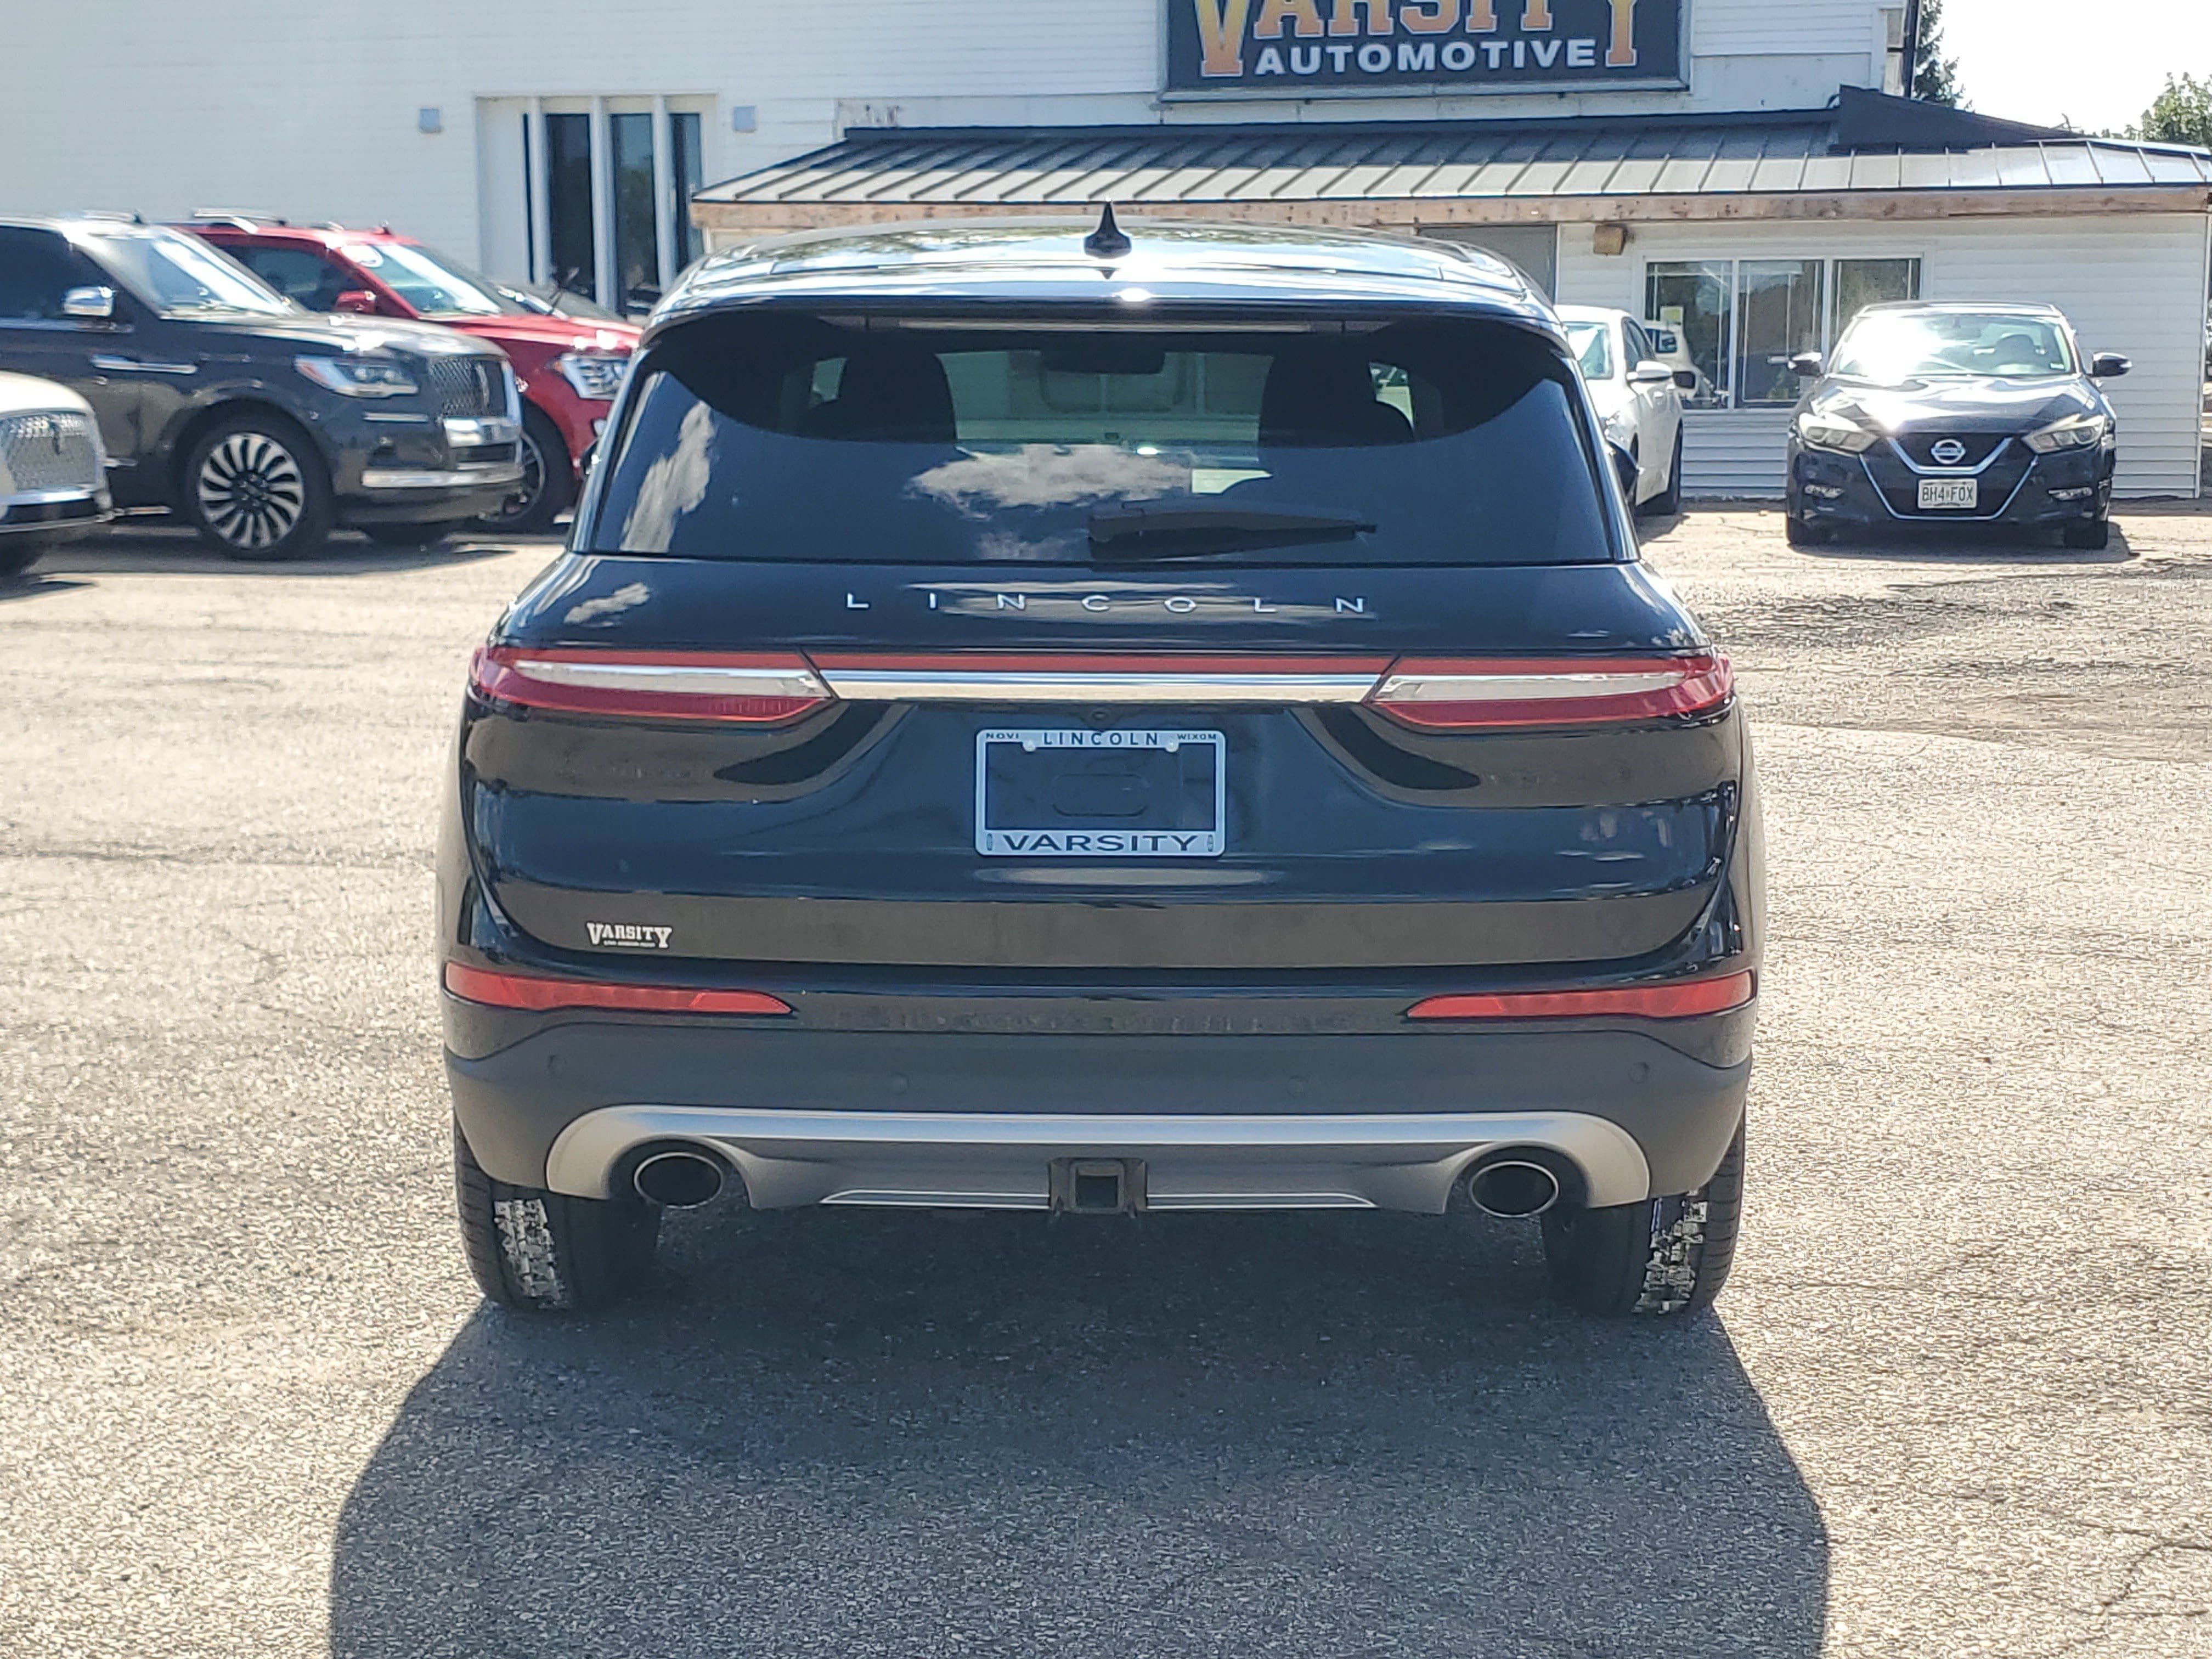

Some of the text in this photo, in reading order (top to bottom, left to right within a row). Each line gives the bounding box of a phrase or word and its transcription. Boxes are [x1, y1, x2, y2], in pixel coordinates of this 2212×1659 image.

[1254, 38, 1597, 75] AUTOMOTIVE
[845, 591, 1365, 613] LINCOLN
[1044, 732, 1158, 745] LINCOLN
[1002, 834, 1198, 852] VARSITY
[586, 922, 673, 949] VARSITY
